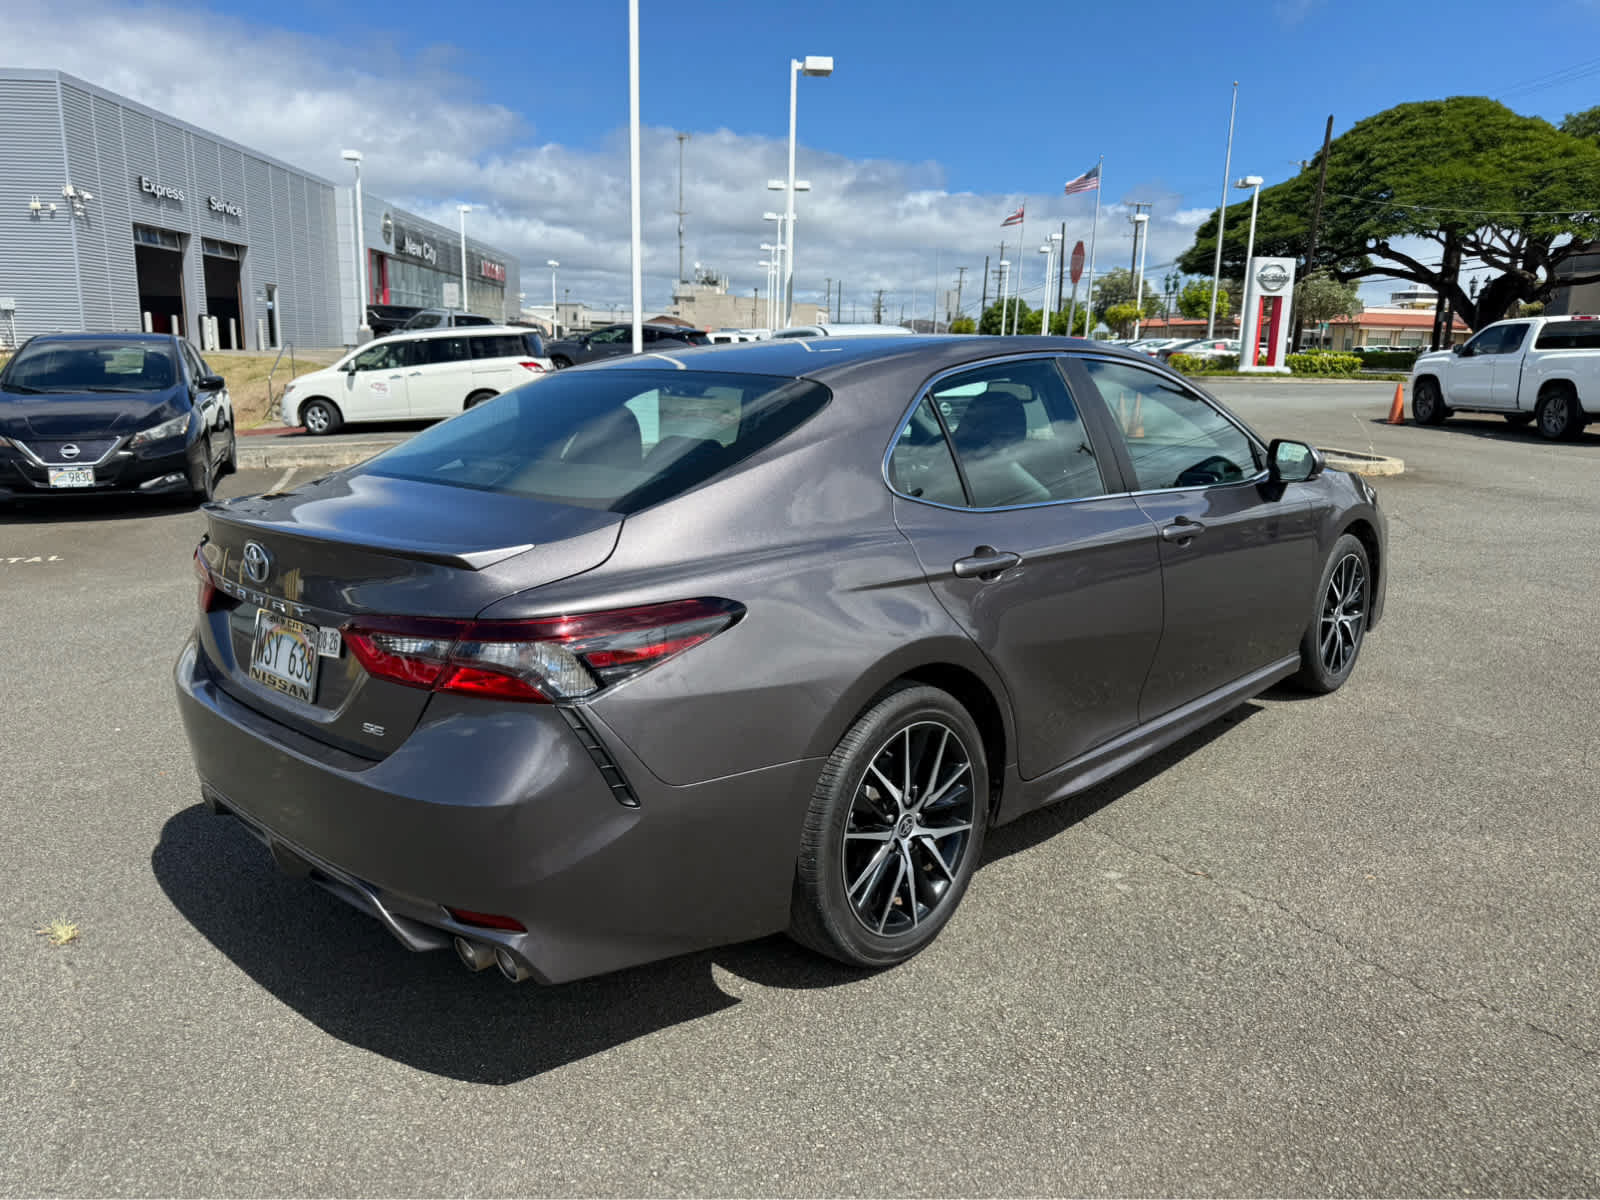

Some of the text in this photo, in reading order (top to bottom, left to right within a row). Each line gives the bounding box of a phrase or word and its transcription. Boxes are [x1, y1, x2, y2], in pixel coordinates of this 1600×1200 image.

[141, 176, 185, 201] Express
[209, 196, 242, 217] Service
[404, 235, 437, 265] New City
[223, 582, 312, 617] CAMRY
[288, 641, 314, 683] 638
[250, 666, 310, 701] NISSAN
[361, 721, 386, 737] SE
